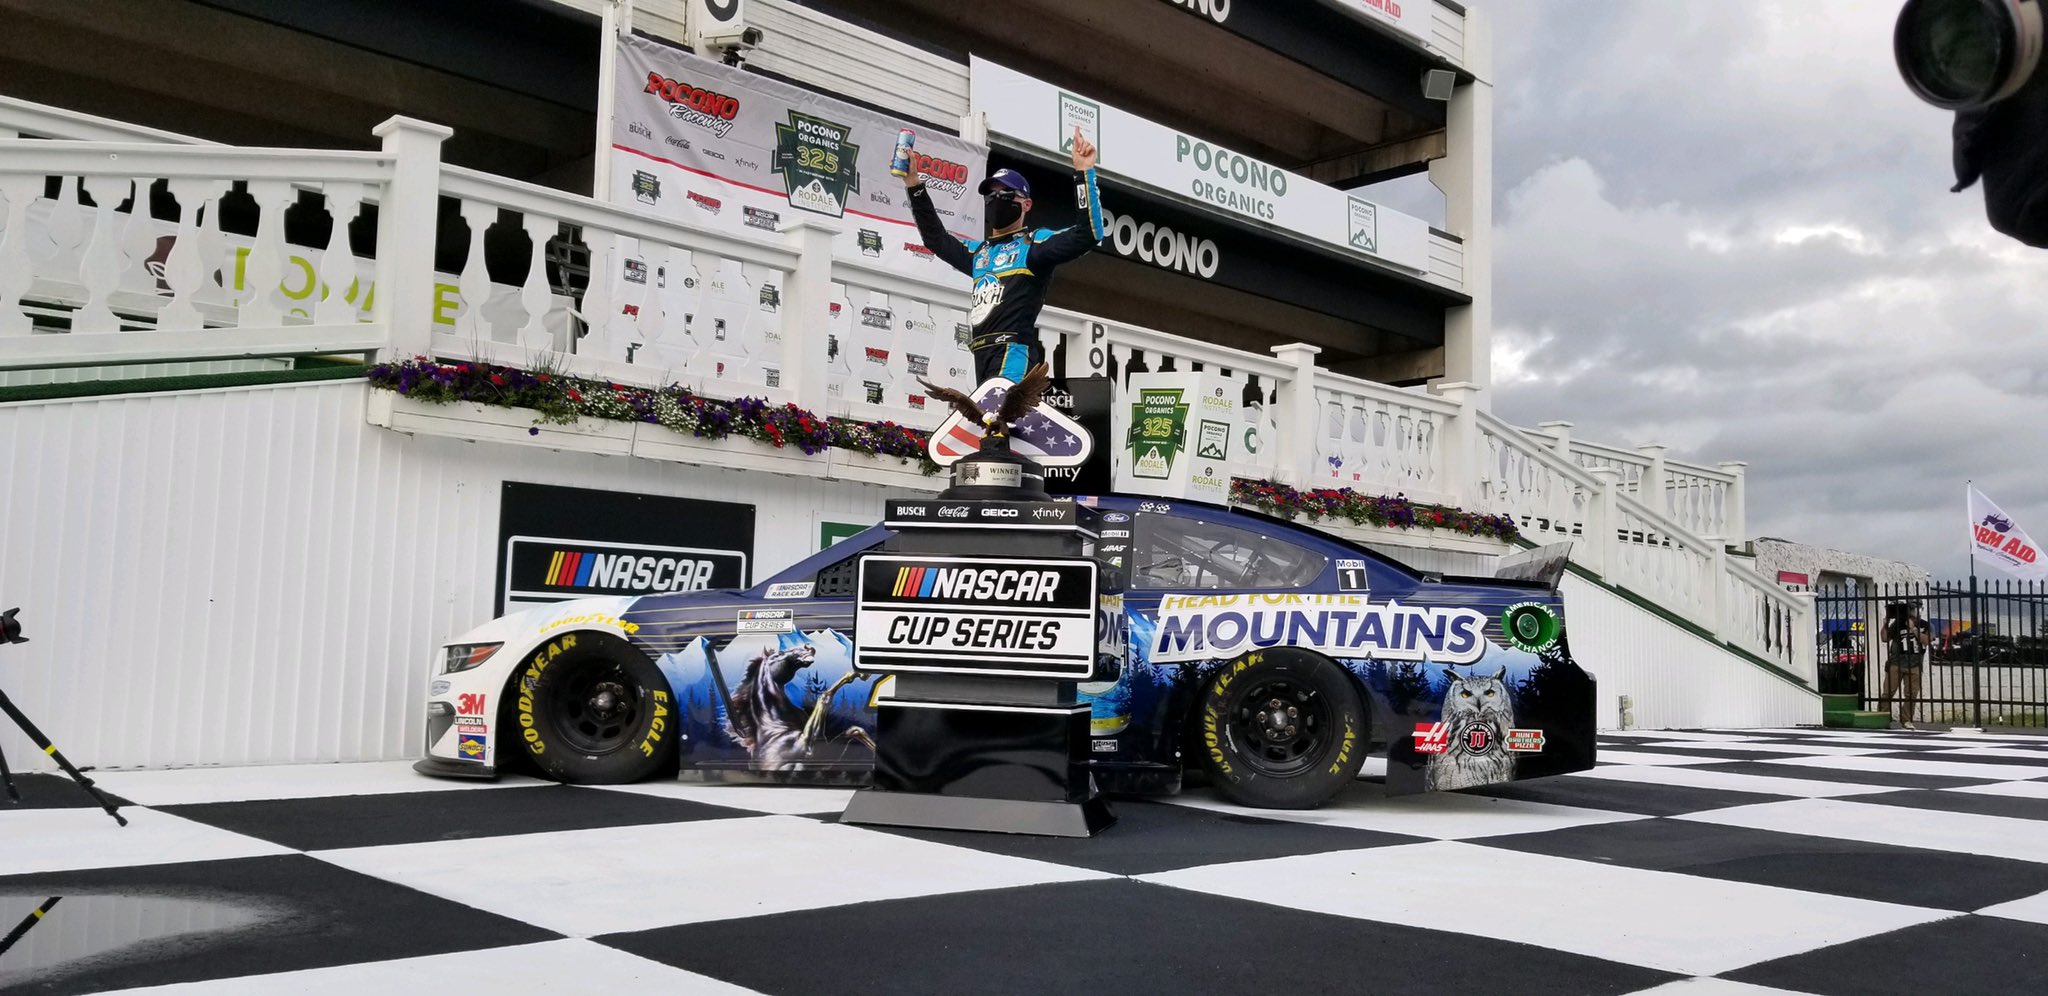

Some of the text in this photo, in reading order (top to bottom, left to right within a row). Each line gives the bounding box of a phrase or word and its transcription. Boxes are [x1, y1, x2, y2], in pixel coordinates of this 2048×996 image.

[643, 71, 739, 121] POCONO
[1064, 102, 1095, 119] POCONO
[669, 102, 733, 139] Raceway
[798, 120, 841, 141] POCONO
[629, 123, 652, 140] BUSCH
[702, 149, 725, 160] GEICO
[735, 158, 759, 171] xfinity
[798, 133, 840, 151] ORGANICS
[796, 146, 839, 173] 325
[1175, 134, 1288, 197] POCONO
[798, 190, 833, 206] RODALE
[870, 193, 891, 205] BUSCH
[1191, 178, 1276, 221] ORGANICS
[1145, 396, 1176, 405] POCONO
[1202, 396, 1233, 408] RODALE
[1142, 417, 1172, 437] 325
[1204, 424, 1226, 433] POCONO
[990, 467, 1019, 475] WINNER
[1140, 460, 1164, 468] RODALE
[1192, 476, 1222, 487] RODALE
[897, 506, 926, 517] BUSCH
[981, 508, 1018, 517] GEICO
[1032, 508, 1066, 520] xfinity
[2001, 537, 2036, 564] AID
[588, 553, 714, 591] NASCAR
[1346, 570, 1357, 588] 1
[930, 568, 1060, 602] NASCAR
[1165, 594, 1239, 610] HEAD
[1505, 601, 1556, 618] AMERICAN
[888, 616, 1061, 650] CUP SERIES
[1157, 610, 1477, 654] MOUNTAINS
[1510, 636, 1557, 654] ETHANOL
[518, 634, 577, 754] GOODYEAR
[457, 693, 486, 715] 3M
[455, 717, 482, 726] LINCOLN
[640, 689, 668, 758] EAGLE
[1415, 743, 1446, 752] HAAS
[1470, 731, 1486, 748] JJ
